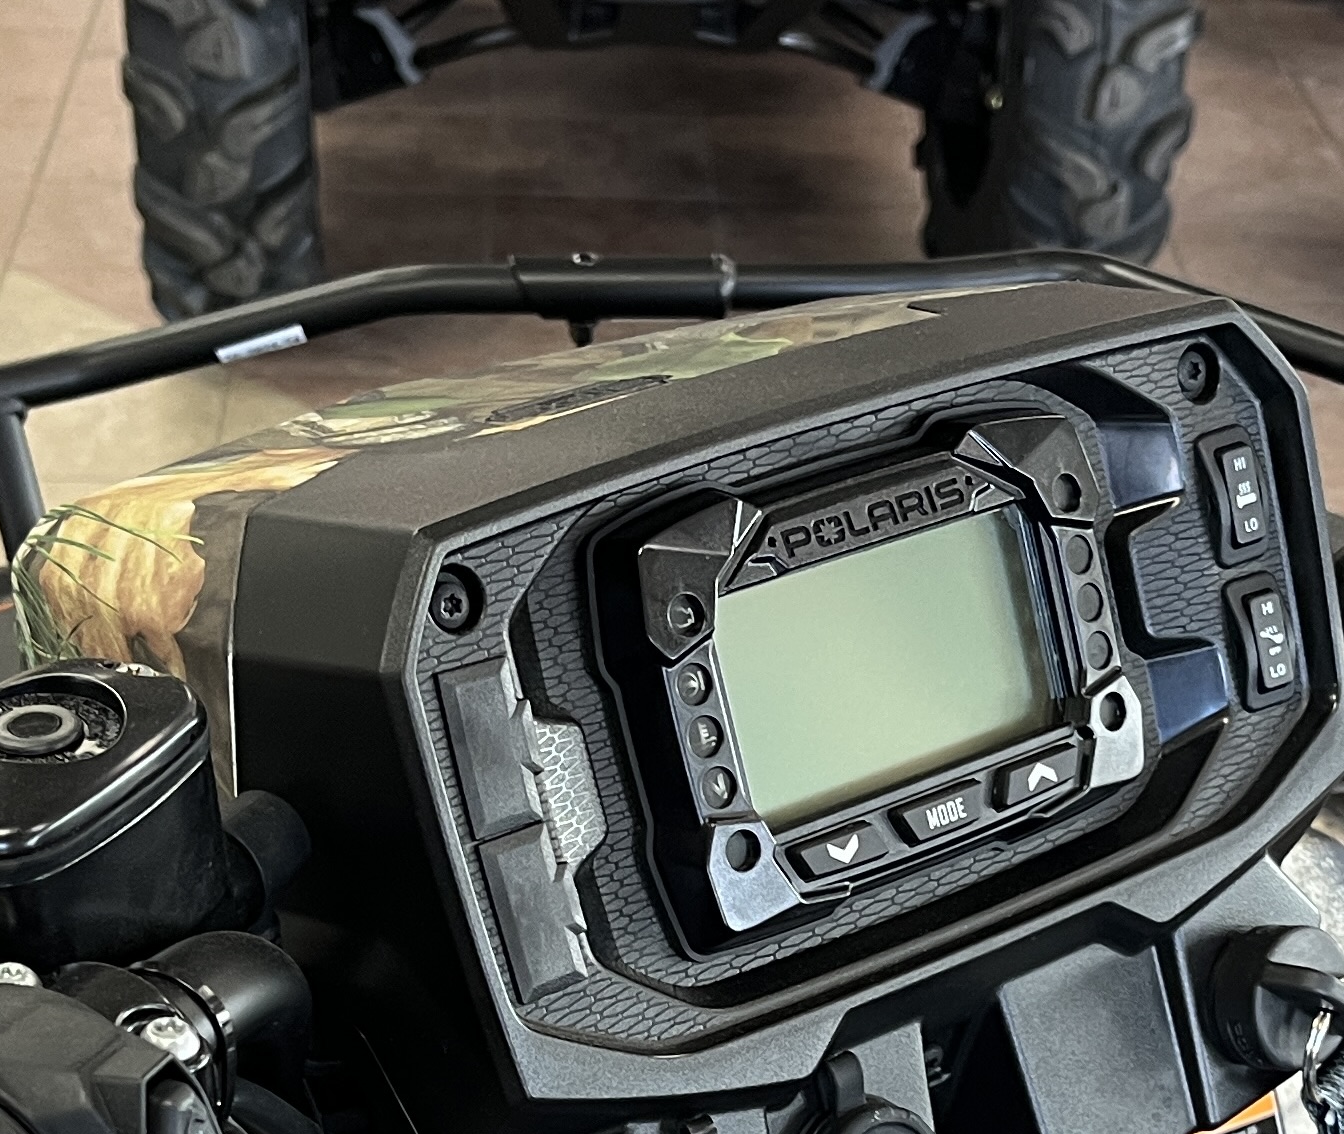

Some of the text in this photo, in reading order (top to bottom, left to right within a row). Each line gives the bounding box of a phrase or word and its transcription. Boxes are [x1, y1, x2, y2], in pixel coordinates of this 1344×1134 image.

[1233, 456, 1247, 472] HI
[779, 476, 966, 560] POLARIS
[1244, 517, 1259, 533] LO
[1269, 663, 1287, 679] LO
[926, 796, 968, 830] MODE
